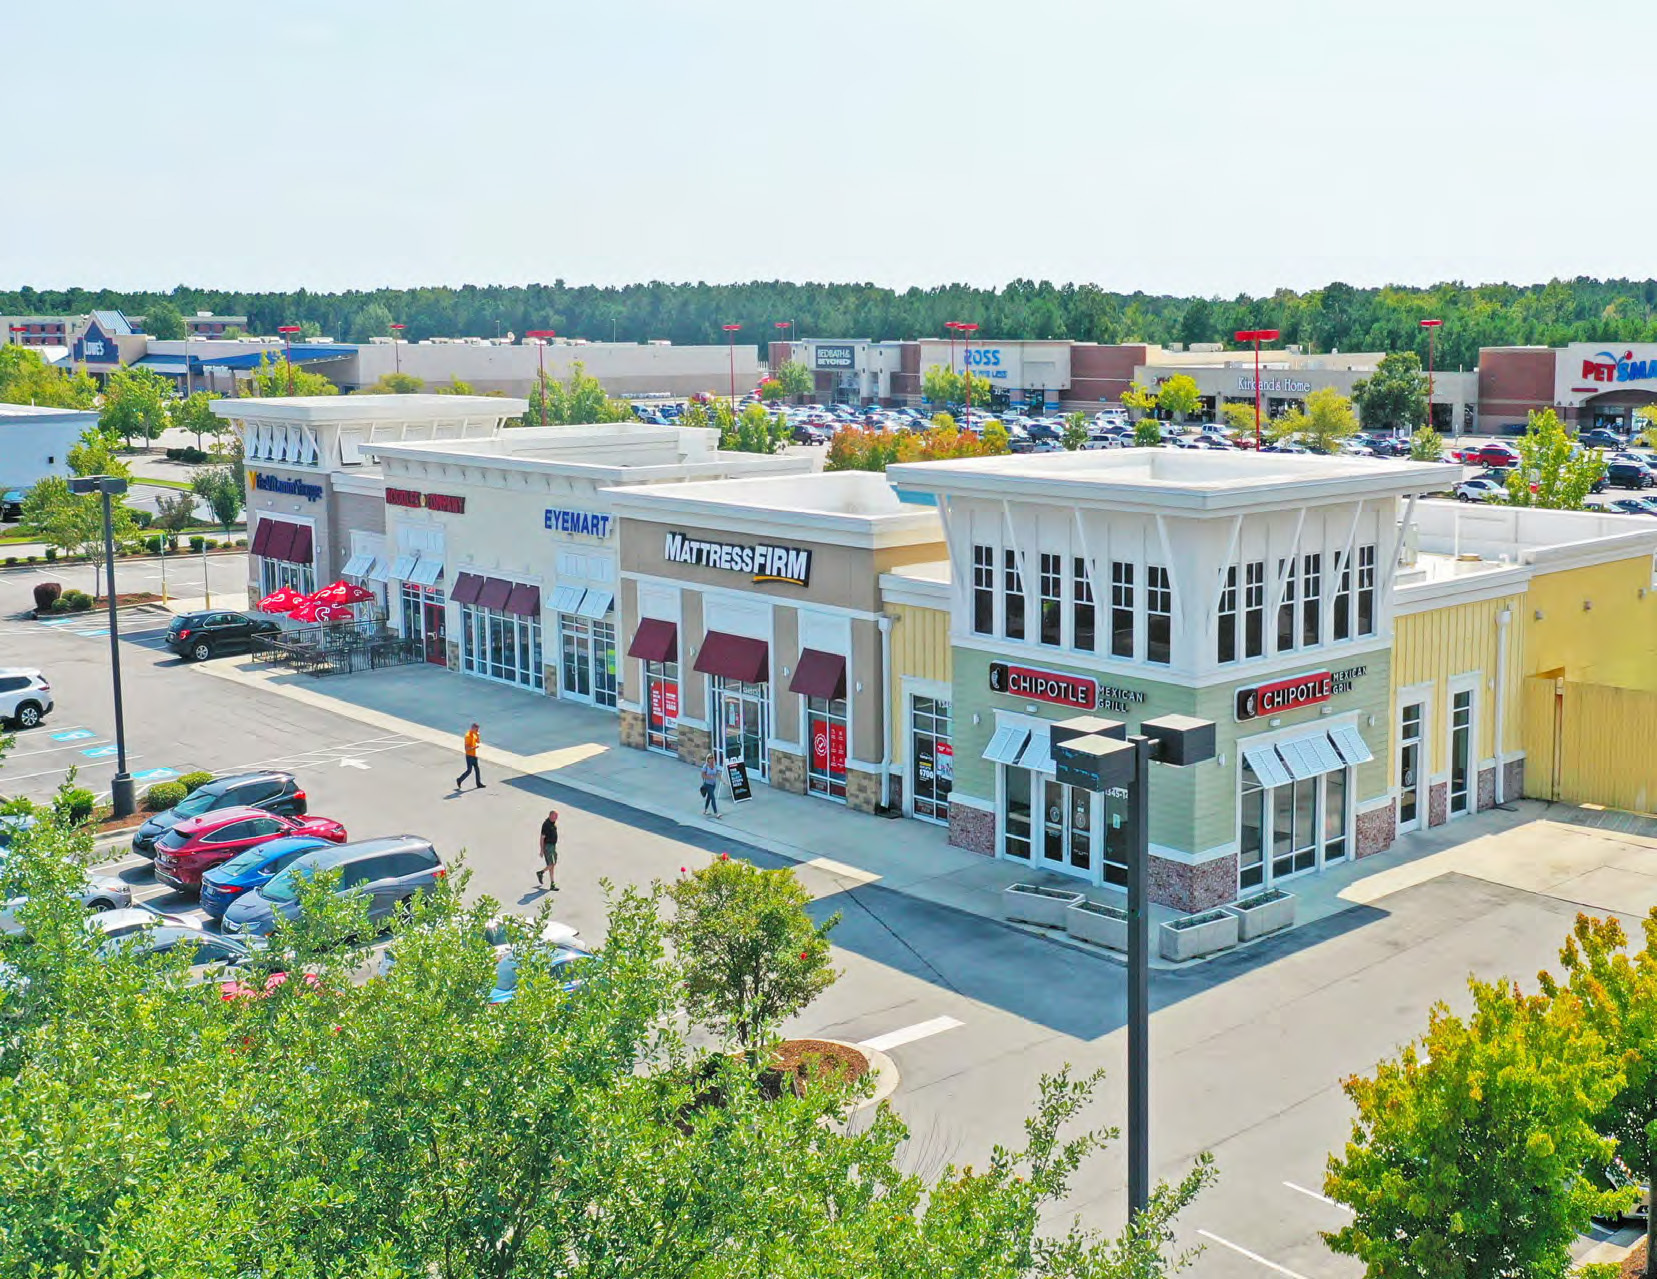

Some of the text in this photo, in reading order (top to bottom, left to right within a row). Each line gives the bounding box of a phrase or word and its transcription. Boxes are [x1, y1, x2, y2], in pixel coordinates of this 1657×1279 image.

[817, 358, 851, 366] BEYOND
[1238, 376, 1312, 392] Kirkand's Home
[544, 509, 609, 538] EYEMART
[1332, 666, 1368, 682] MEXICAN
[1009, 674, 1087, 704] CHIPOTLE
[1098, 686, 1145, 703] MEXICAN
[1263, 679, 1331, 710] CHIPOTLE
[1098, 700, 1127, 713] GRILL
